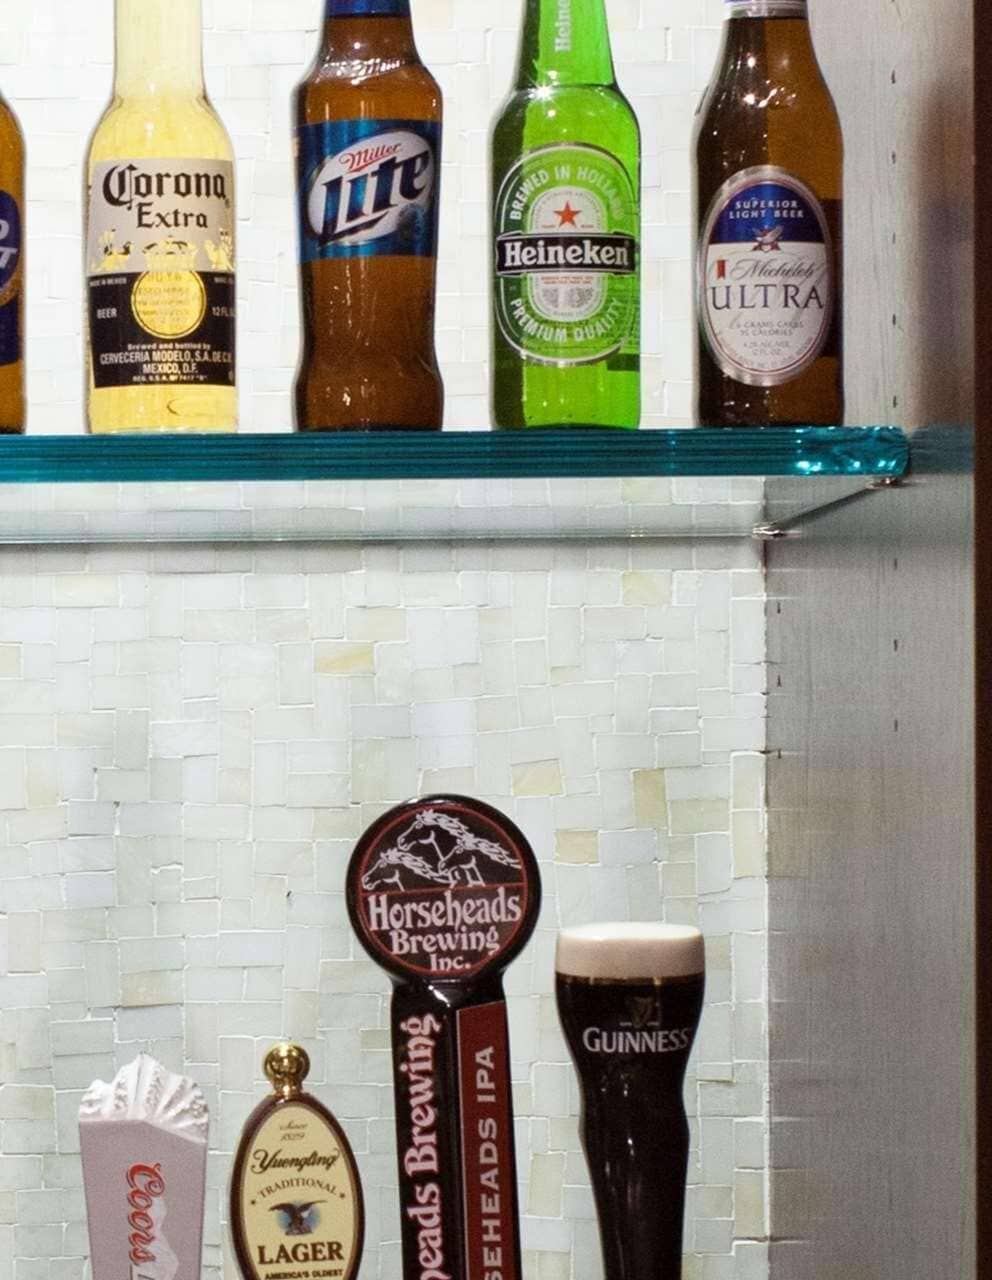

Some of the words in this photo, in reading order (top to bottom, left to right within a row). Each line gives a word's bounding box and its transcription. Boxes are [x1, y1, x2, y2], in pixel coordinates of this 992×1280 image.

[339, 142, 402, 174] Miller
[102, 163, 227, 211] Corona
[509, 169, 549, 221] BREWED
[554, 164, 571, 181] IN
[577, 165, 625, 221] HOLLAND
[136, 201, 209, 229] Extra
[729, 209, 767, 219] LIGHT
[773, 209, 805, 219] BEER
[735, 199, 799, 210] SUPERIOR
[504, 240, 628, 267] Heineken
[730, 258, 817, 282] Michelob
[711, 283, 824, 311] ULTRA
[96, 308, 118, 319] BEER
[510, 298, 568, 342] PREMIUM
[574, 297, 624, 342] QUALITY
[100, 351, 151, 365] CERVECERIA
[142, 363, 182, 374] MEXICO,
[368, 886, 522, 932] Horseheads
[389, 925, 501, 957] Brewing
[429, 953, 472, 972] Inc.
[582, 1026, 693, 1054] GUINNESS
[474, 1045, 497, 1103] IPA
[399, 1012, 442, 1178] Brewing
[250, 1147, 341, 1175] Yuengling
[259, 1177, 338, 1199] TRADITIONAL
[126, 1161, 166, 1267] Coors
[258, 1240, 345, 1265] LAGER
[264, 1270, 310, 1280] AMERICA'S
[311, 1268, 344, 1278] OLDEST
